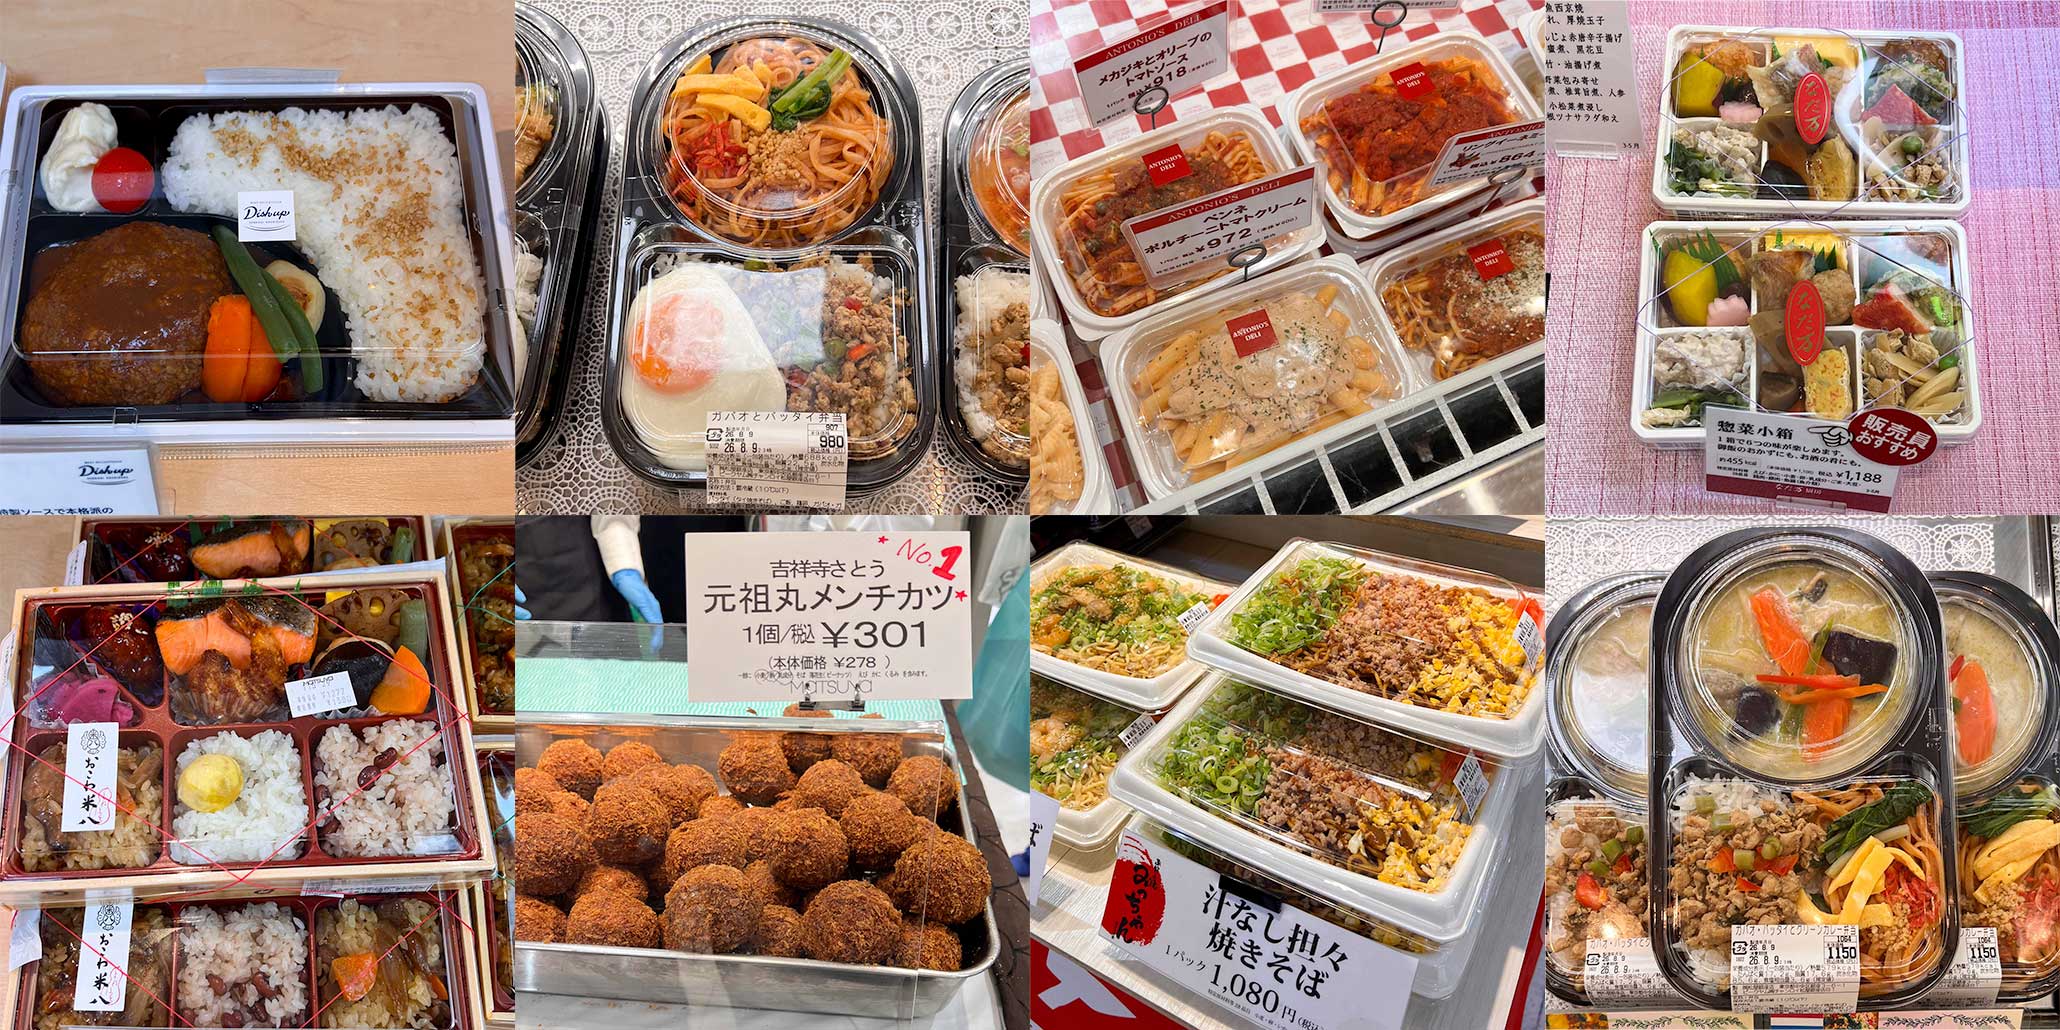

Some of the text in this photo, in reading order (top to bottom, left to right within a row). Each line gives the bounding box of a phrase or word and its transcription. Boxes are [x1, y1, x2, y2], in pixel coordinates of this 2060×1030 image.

[1105, 13, 1203, 60] ANTONIO'S DELI
[1547, 15, 1605, 26] れ、厚焼玉子
[1099, 31, 1212, 87] メカジキとオリーブの
[1125, 53, 1189, 87] トマトソース
[1167, 180, 1281, 222] ANTONIO'S DELI
[1203, 205, 1248, 224] ペンネ
[1143, 196, 1308, 255] ポルチーニトマトクリーム
[1195, 227, 1253, 254] ¥972
[819, 435, 845, 449] 980
[1717, 420, 1794, 440] 惣菜小箱
[1855, 430, 1919, 461] おすすめ
[1863, 413, 1932, 450] 販売員
[1836, 469, 1883, 484] ¥1,188
[769, 559, 885, 579] 吉祥寺さとう
[703, 581, 954, 614] 元祖丸メンチカツ
[820, 620, 926, 648] ¥301
[833, 657, 877, 669] ¥278
[79, 756, 100, 825] おこわ米八
[1202, 883, 1349, 973] 汁なし担々
[1205, 921, 1330, 1000] 焼きそば
[1827, 946, 1857, 960] 1150
[1970, 946, 1997, 959] 1150
[89, 933, 110, 1005] おこわ米八
[1209, 964, 1280, 1014] 1,080
[1281, 1005, 1297, 1024] 円
